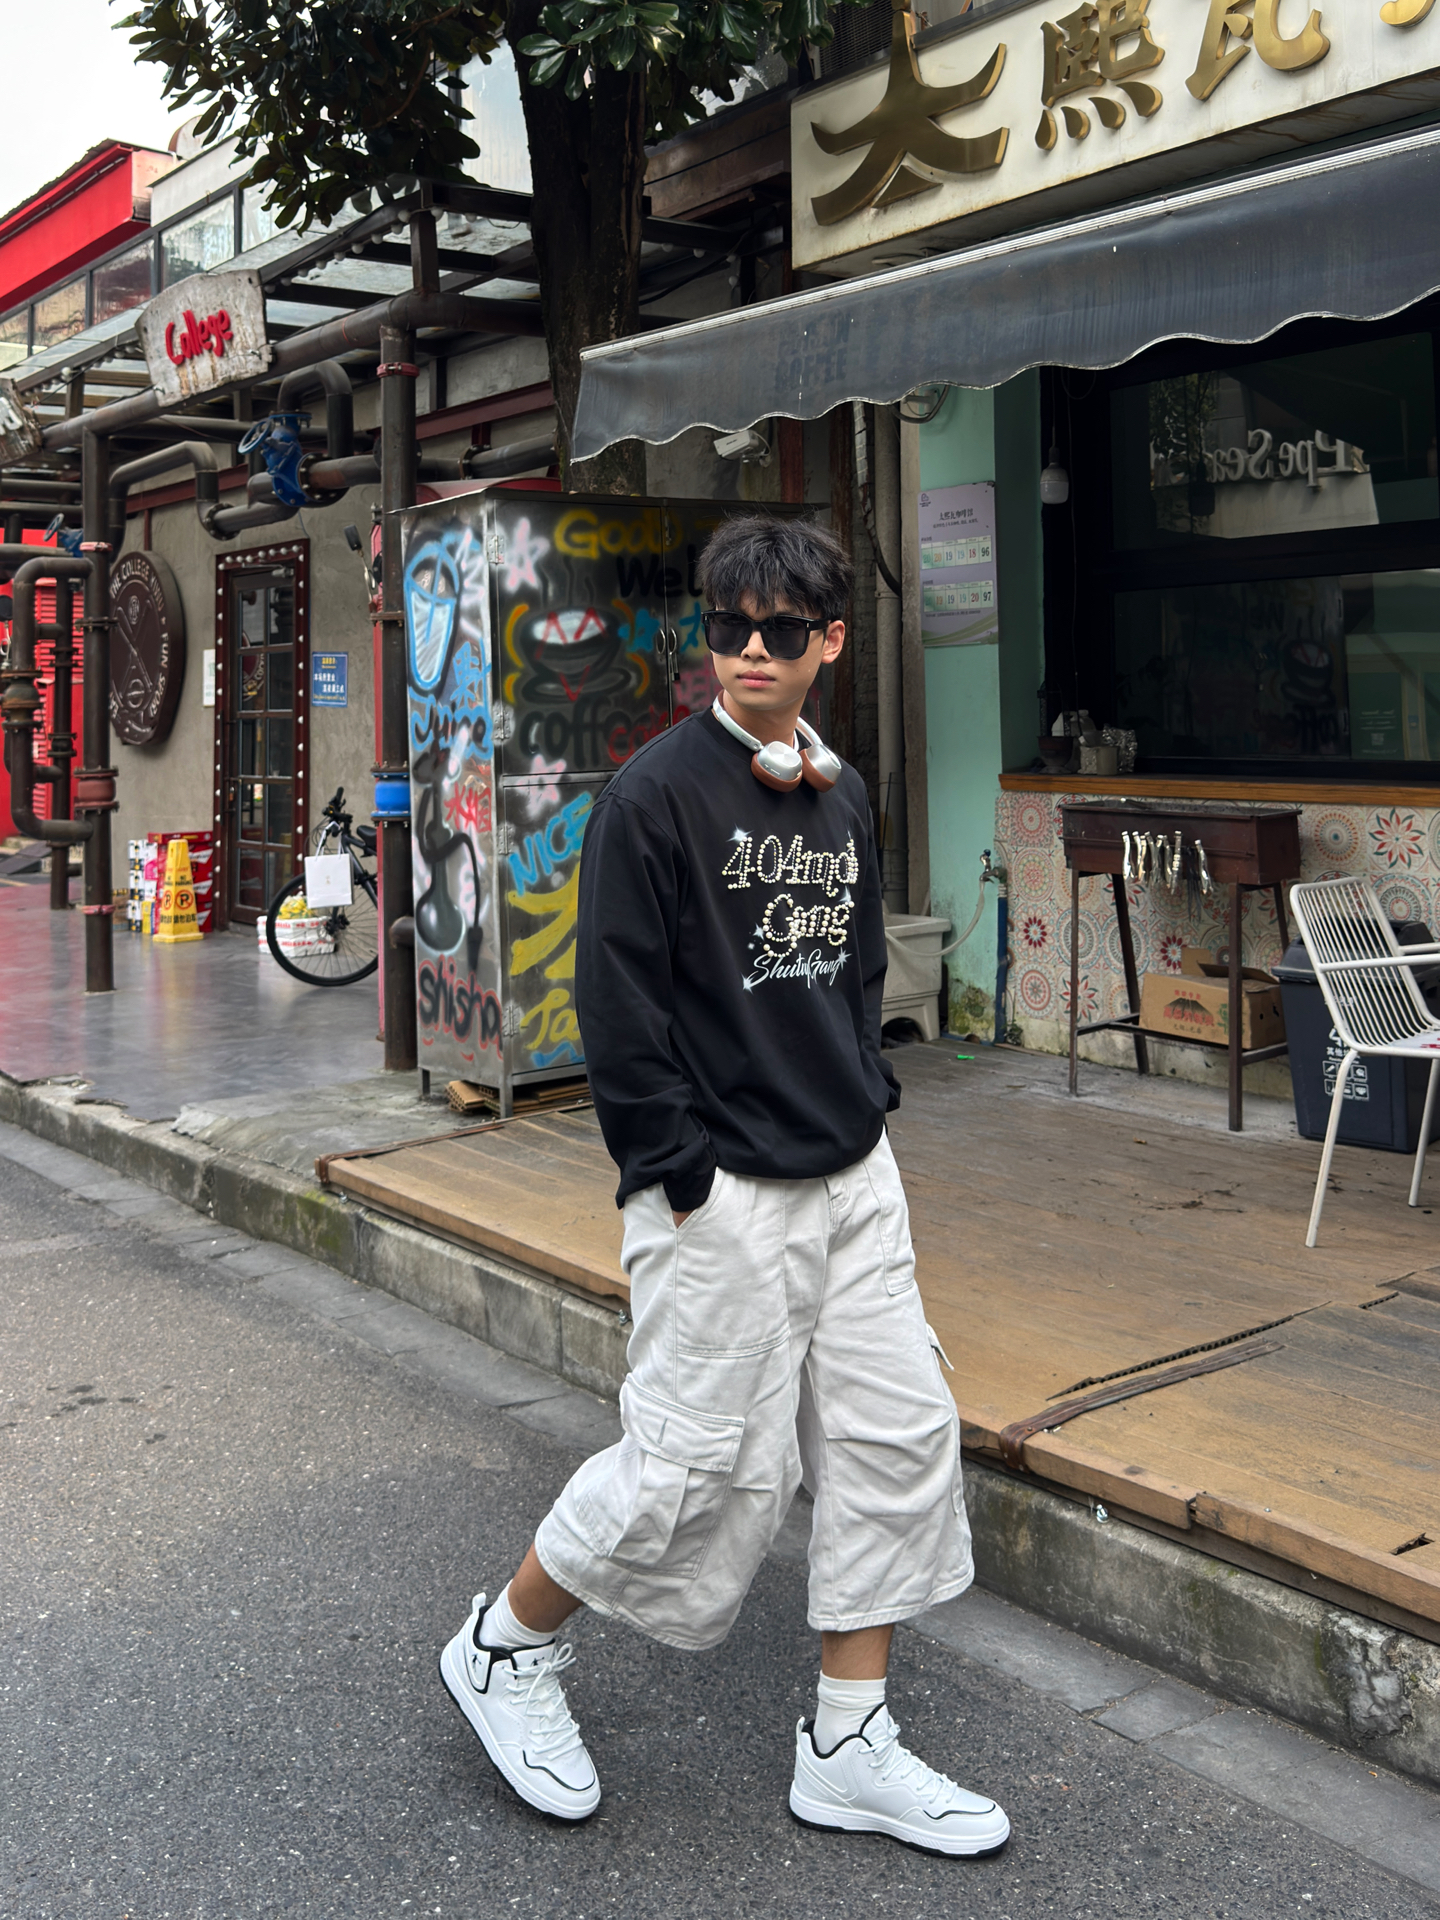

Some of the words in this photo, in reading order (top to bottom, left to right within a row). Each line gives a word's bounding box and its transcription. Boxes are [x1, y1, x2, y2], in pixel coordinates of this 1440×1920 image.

[165, 309, 233, 366] College
[615, 544, 704, 598] Wel
[981, 546, 990, 557] 96
[109, 572, 122, 599] THE
[121, 558, 149, 582] COLLEGE
[161, 632, 169, 669] FUN
[983, 591, 992, 602] 97
[508, 790, 594, 896] NICE
